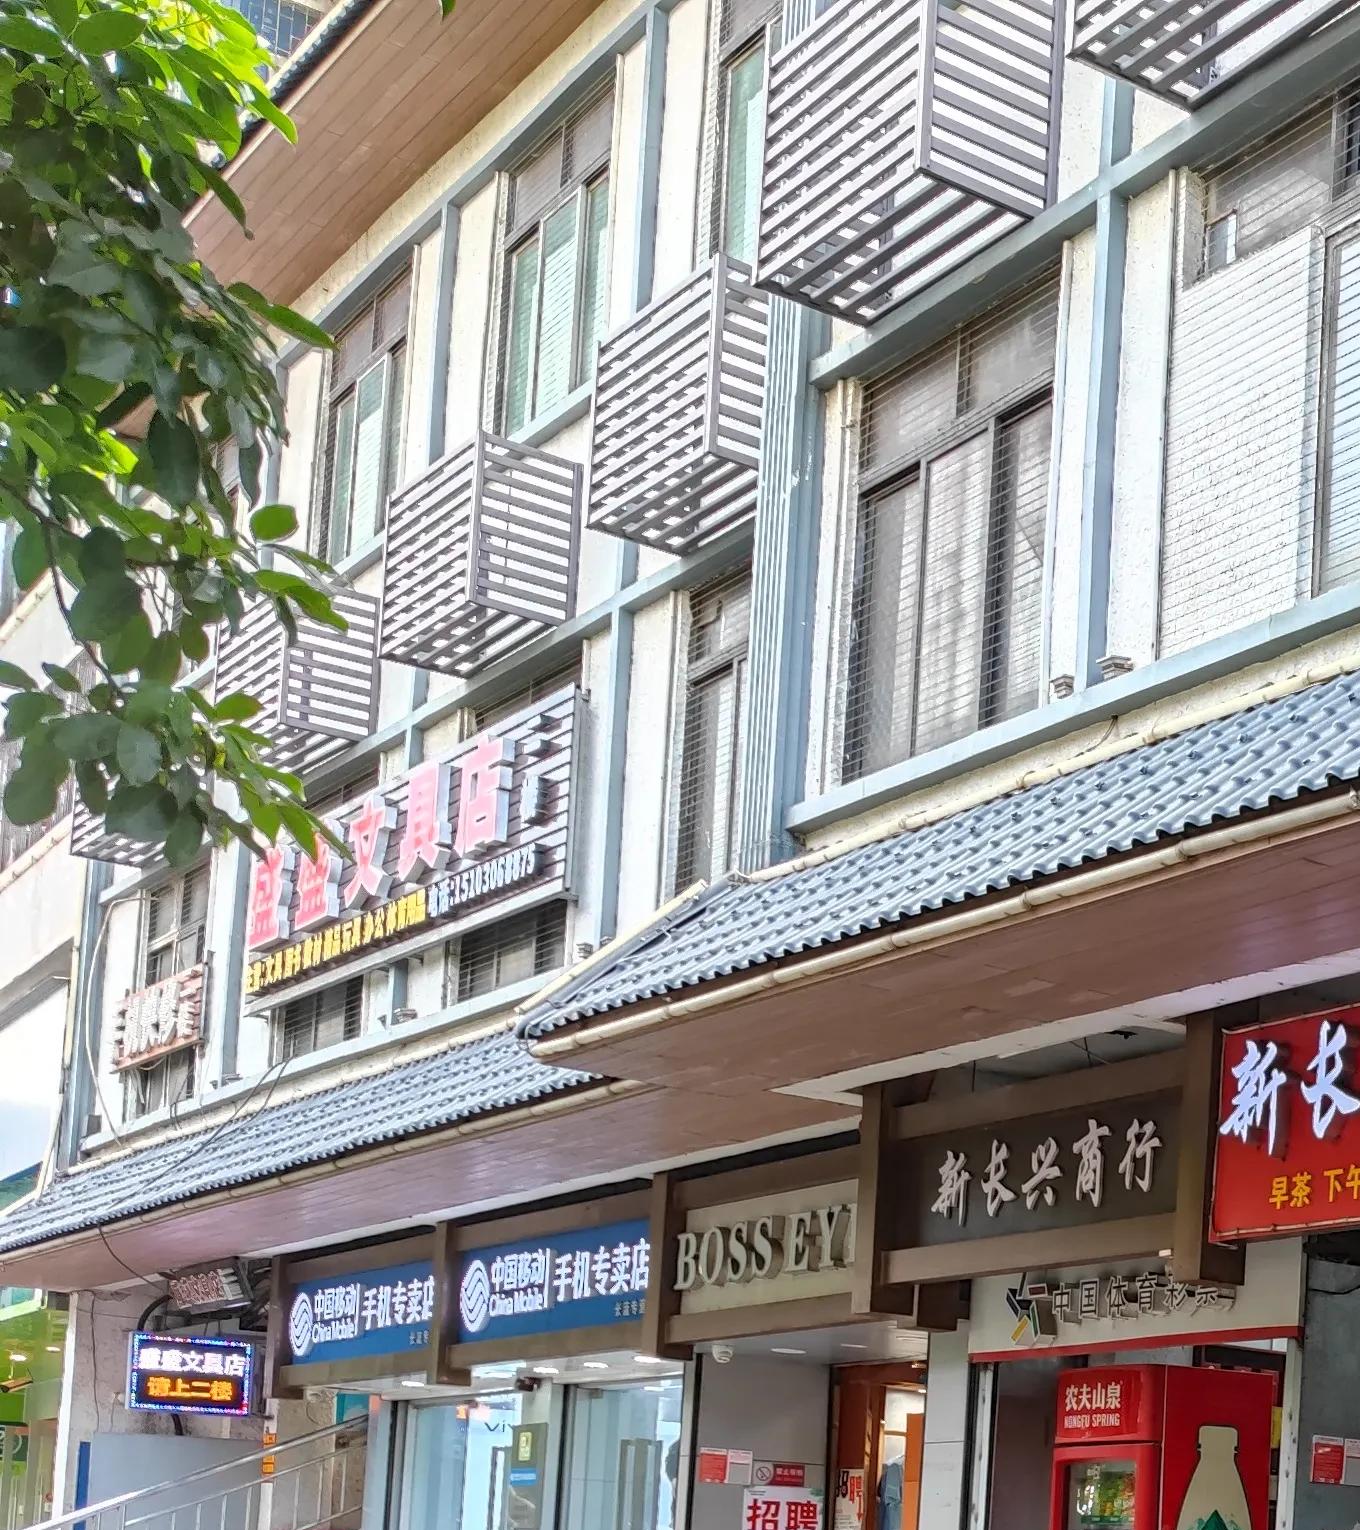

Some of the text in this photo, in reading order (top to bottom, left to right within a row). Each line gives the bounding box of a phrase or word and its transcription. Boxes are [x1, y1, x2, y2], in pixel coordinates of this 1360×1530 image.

[930, 1118, 1163, 1226] 新长兴商行
[1269, 1173, 1311, 1210] 早茶
[491, 1238, 650, 1302] 中国移动 手机专卖店
[314, 1284, 356, 1319] 中国移动
[147, 1376, 232, 1401] 请上二楼
[1065, 1382, 1121, 1411] 农夫山泉
[1091, 1413, 1120, 1427] SPRING
